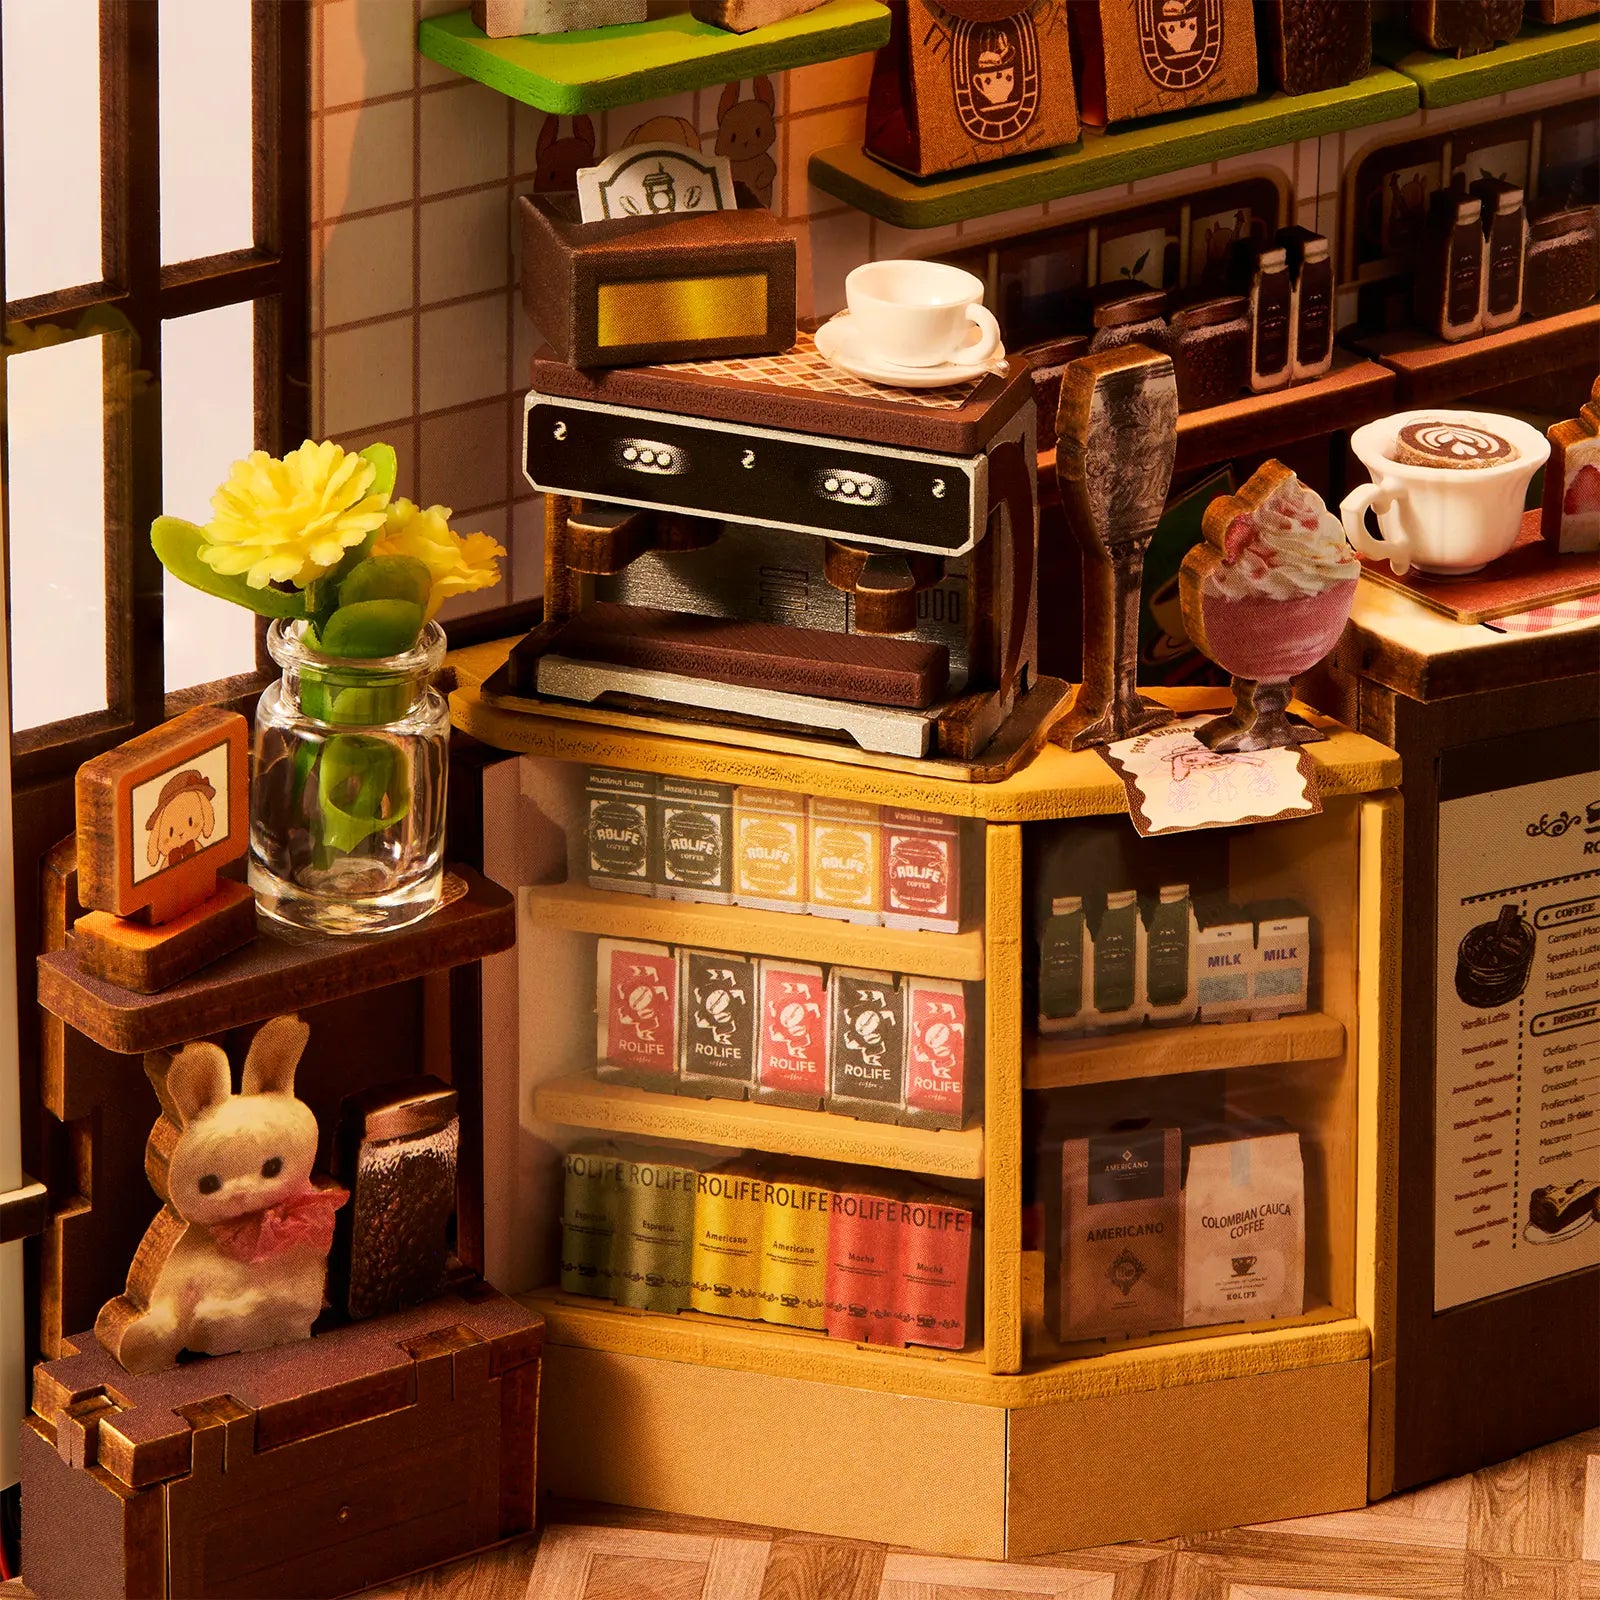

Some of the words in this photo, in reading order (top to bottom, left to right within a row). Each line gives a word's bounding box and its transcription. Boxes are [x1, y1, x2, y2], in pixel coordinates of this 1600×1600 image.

[1555, 902, 1596, 919] COFFEE
[1208, 953, 1242, 968] MILK
[1264, 947, 1298, 962] MILK
[1553, 1007, 1598, 1025] DESSERT
[618, 1039, 665, 1056] ROLIFE
[695, 1043, 742, 1059] ROLIFE
[769, 1056, 817, 1073] ROLIFE
[844, 1064, 891, 1081] ROLIFE
[914, 1077, 961, 1093] ROLIFE
[563, 1154, 625, 1181] ROLIFE
[1105, 1160, 1149, 1173] AMERICANO
[629, 1165, 693, 1193] ROLIFE
[697, 1174, 762, 1202] ROLIFE
[764, 1184, 829, 1212] ROLIFE
[832, 1194, 897, 1222] ROLIFE
[1201, 1206, 1258, 1229] COLOMBIAN
[1259, 1202, 1292, 1217] CAUCA
[901, 1204, 966, 1232] ROLIFE
[1086, 1221, 1164, 1243] AMERICANO
[1230, 1218, 1265, 1239] COFFEE
[705, 1230, 748, 1245] Americano
[773, 1240, 815, 1254] Americano
